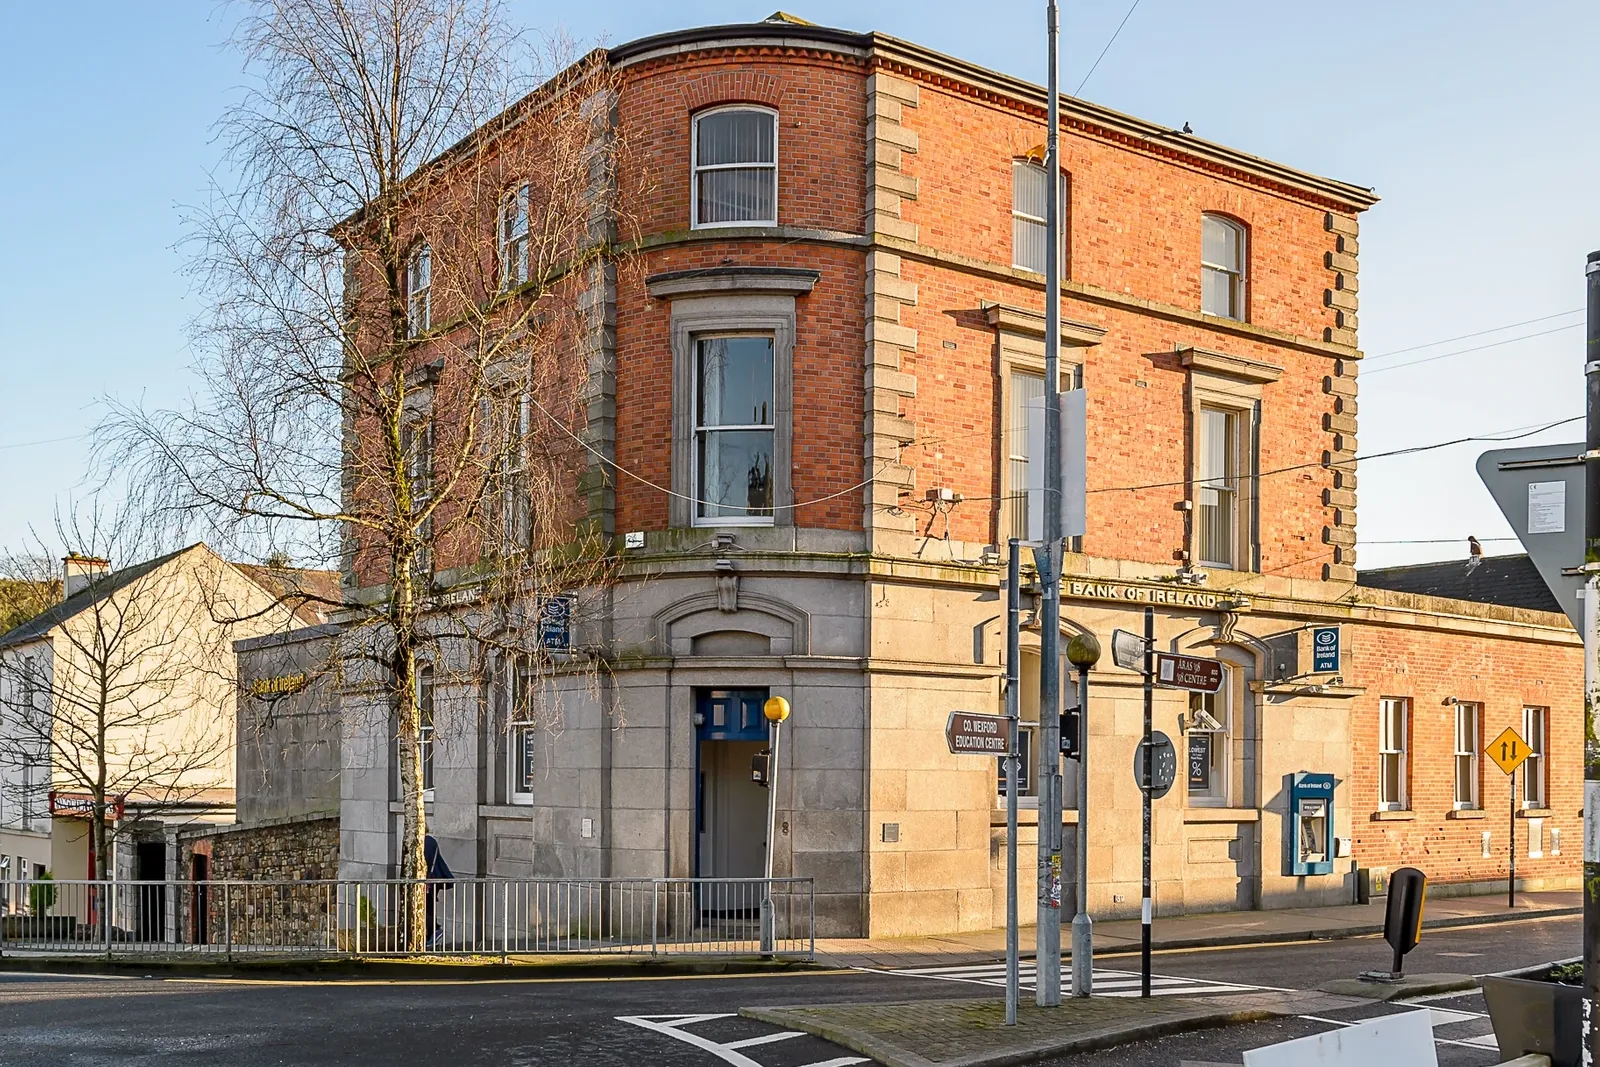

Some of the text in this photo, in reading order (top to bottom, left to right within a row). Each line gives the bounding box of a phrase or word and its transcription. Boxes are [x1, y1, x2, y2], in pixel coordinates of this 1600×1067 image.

[1072, 582, 1119, 598] BANK
[1127, 588, 1145, 600] OF
[1152, 590, 1217, 608] IRELAND
[1330, 644, 1336, 652] of
[1184, 673, 1207, 686] CENTRE
[963, 719, 997, 733] CO. WEXFORD
[955, 735, 1005, 750] EDUCATION CENTRE
